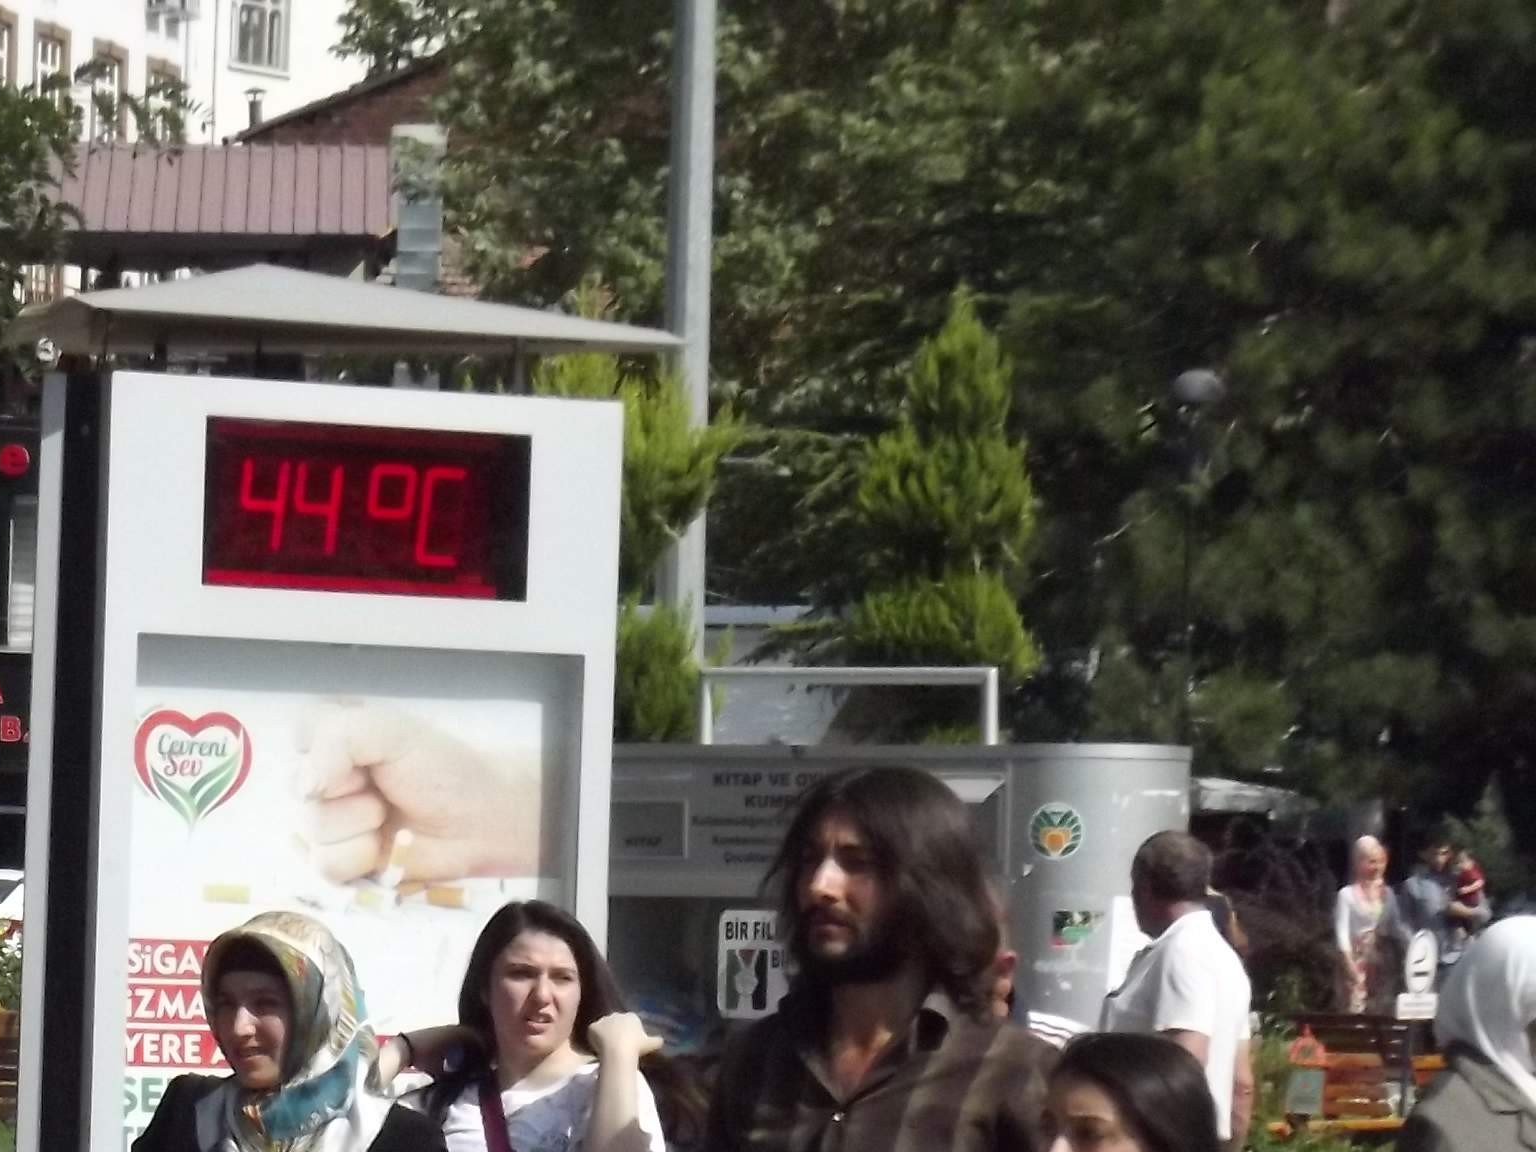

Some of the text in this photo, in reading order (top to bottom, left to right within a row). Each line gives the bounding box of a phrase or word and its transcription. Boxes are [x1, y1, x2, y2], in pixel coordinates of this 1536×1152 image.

[158, 733, 228, 761] Çevreni
[163, 751, 202, 777] Sev
[725, 918, 748, 940] BİR
[128, 941, 208, 976] SiGA
[126, 1032, 203, 1065] YERE
